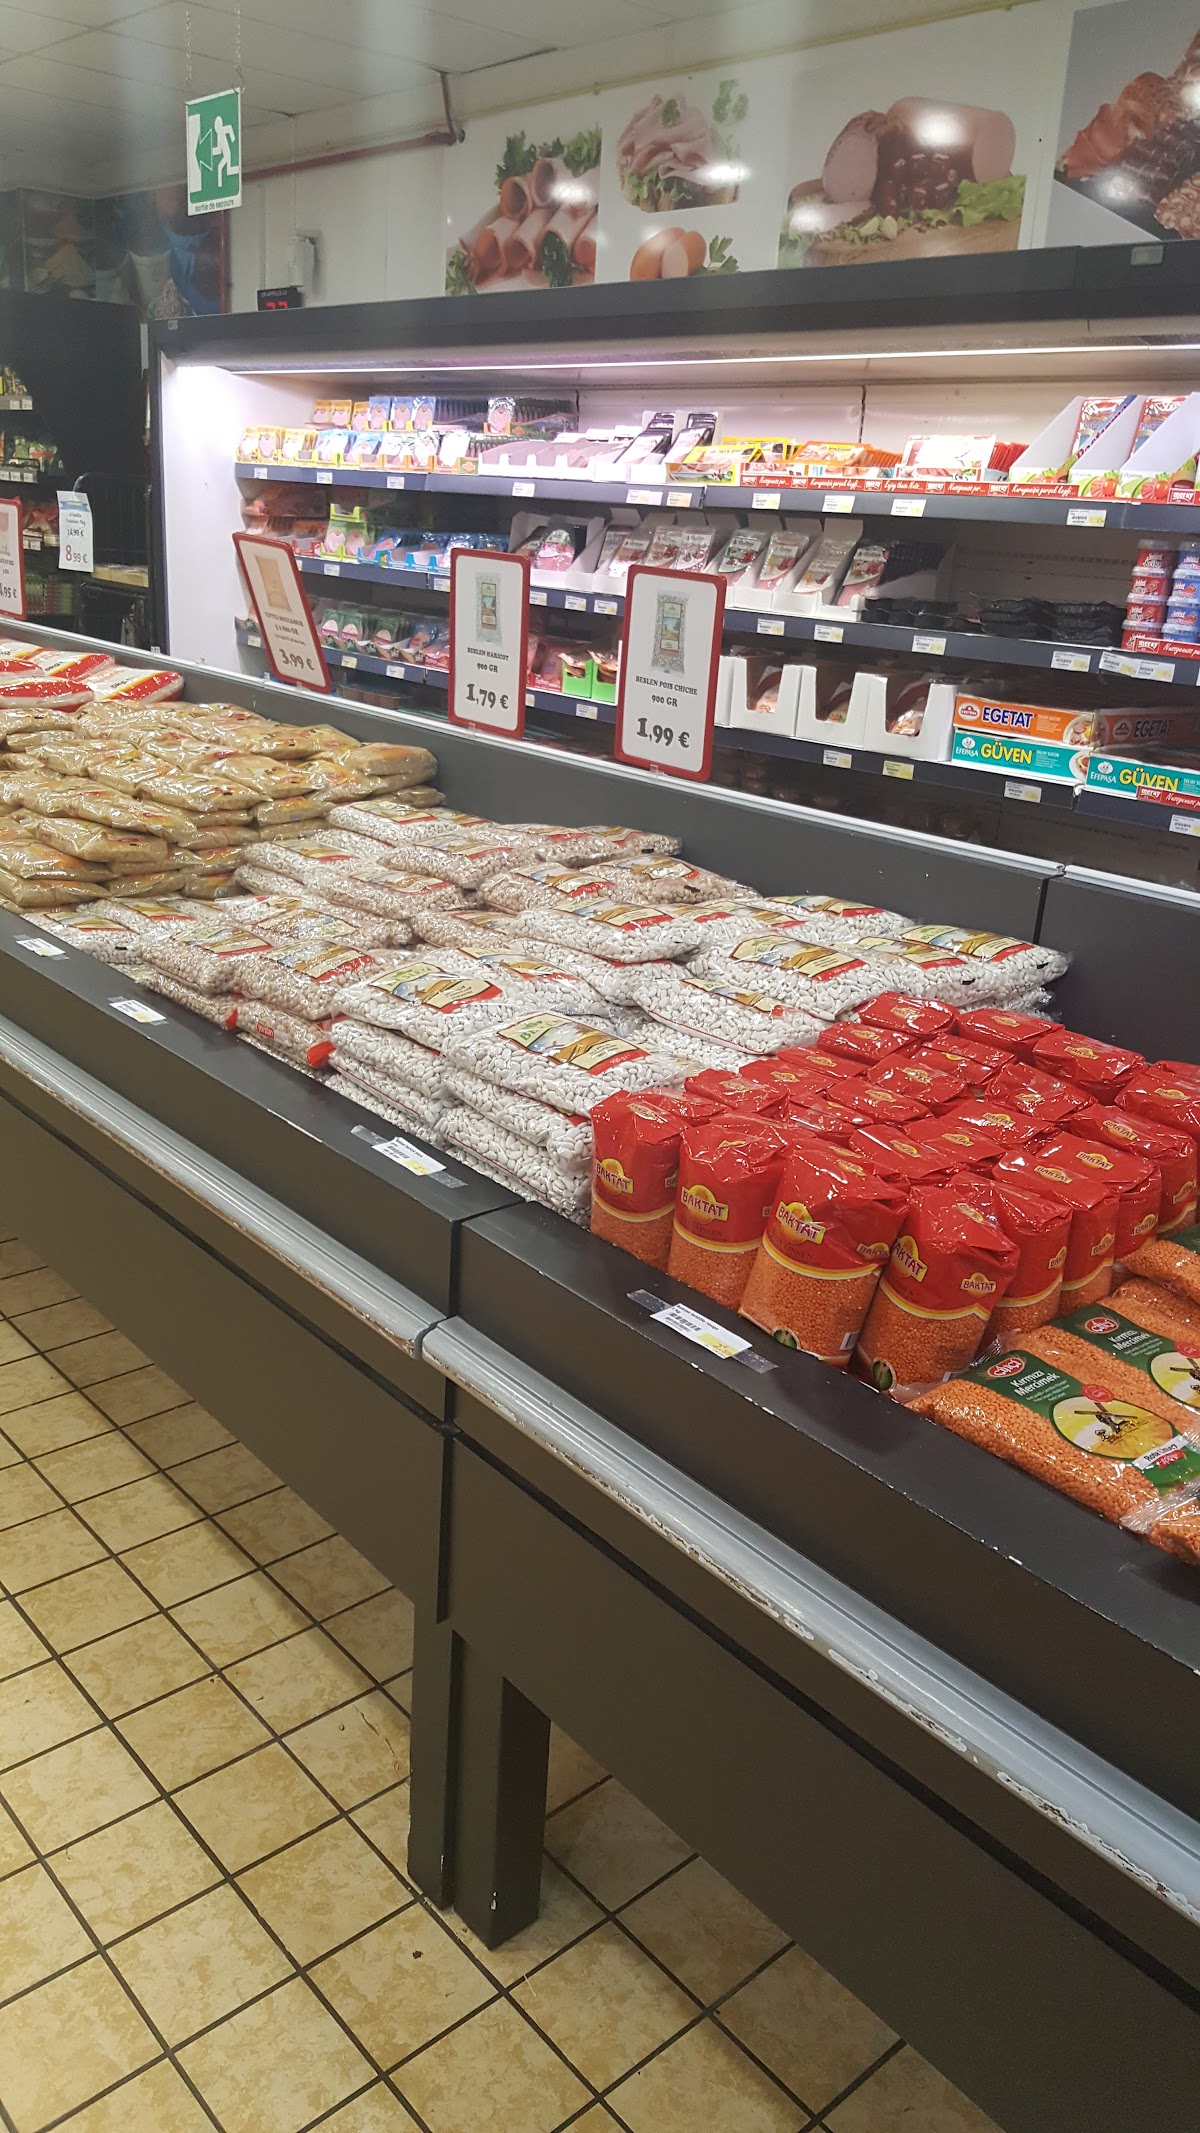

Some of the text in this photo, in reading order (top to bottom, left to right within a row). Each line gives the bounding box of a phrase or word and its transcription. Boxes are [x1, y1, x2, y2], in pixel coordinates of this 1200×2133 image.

[216, 199, 234, 209] secours
[82, 554, 88, 564] €
[12, 588, 17, 598] €
[279, 648, 314, 670] 3,99 €
[486, 651, 509, 661] HARICOT
[476, 662, 498, 673] 900 GR
[636, 676, 698, 696] BESLEN POIS CHICHE
[466, 684, 508, 710] 1,79 €
[652, 694, 678, 708] 900 GR
[982, 706, 1034, 728] EGETAT
[636, 718, 690, 748] 1,99 €
[981, 742, 1032, 764] GÜVEN
[1120, 768, 1178, 792] GÜVEN
[1066, 1048, 1096, 1060] BAKTAT
[1106, 1122, 1135, 1139] BAKTAT
[1078, 1152, 1111, 1169] BAKTAT
[596, 1164, 630, 1190] BAKTAT
[1036, 1166, 1070, 1182] BAKTAT
[682, 1190, 724, 1217] BAKTAT
[778, 1206, 820, 1240] BAKTAT
[860, 1246, 889, 1258] BAKTA
[892, 1242, 924, 1276] AKTAT
[964, 1280, 994, 1290] BAKTAT
[1112, 1332, 1152, 1351] Mercimek
[1010, 1370, 1045, 1388] Kırmızı
[1014, 1372, 1060, 1397] Mercimek
